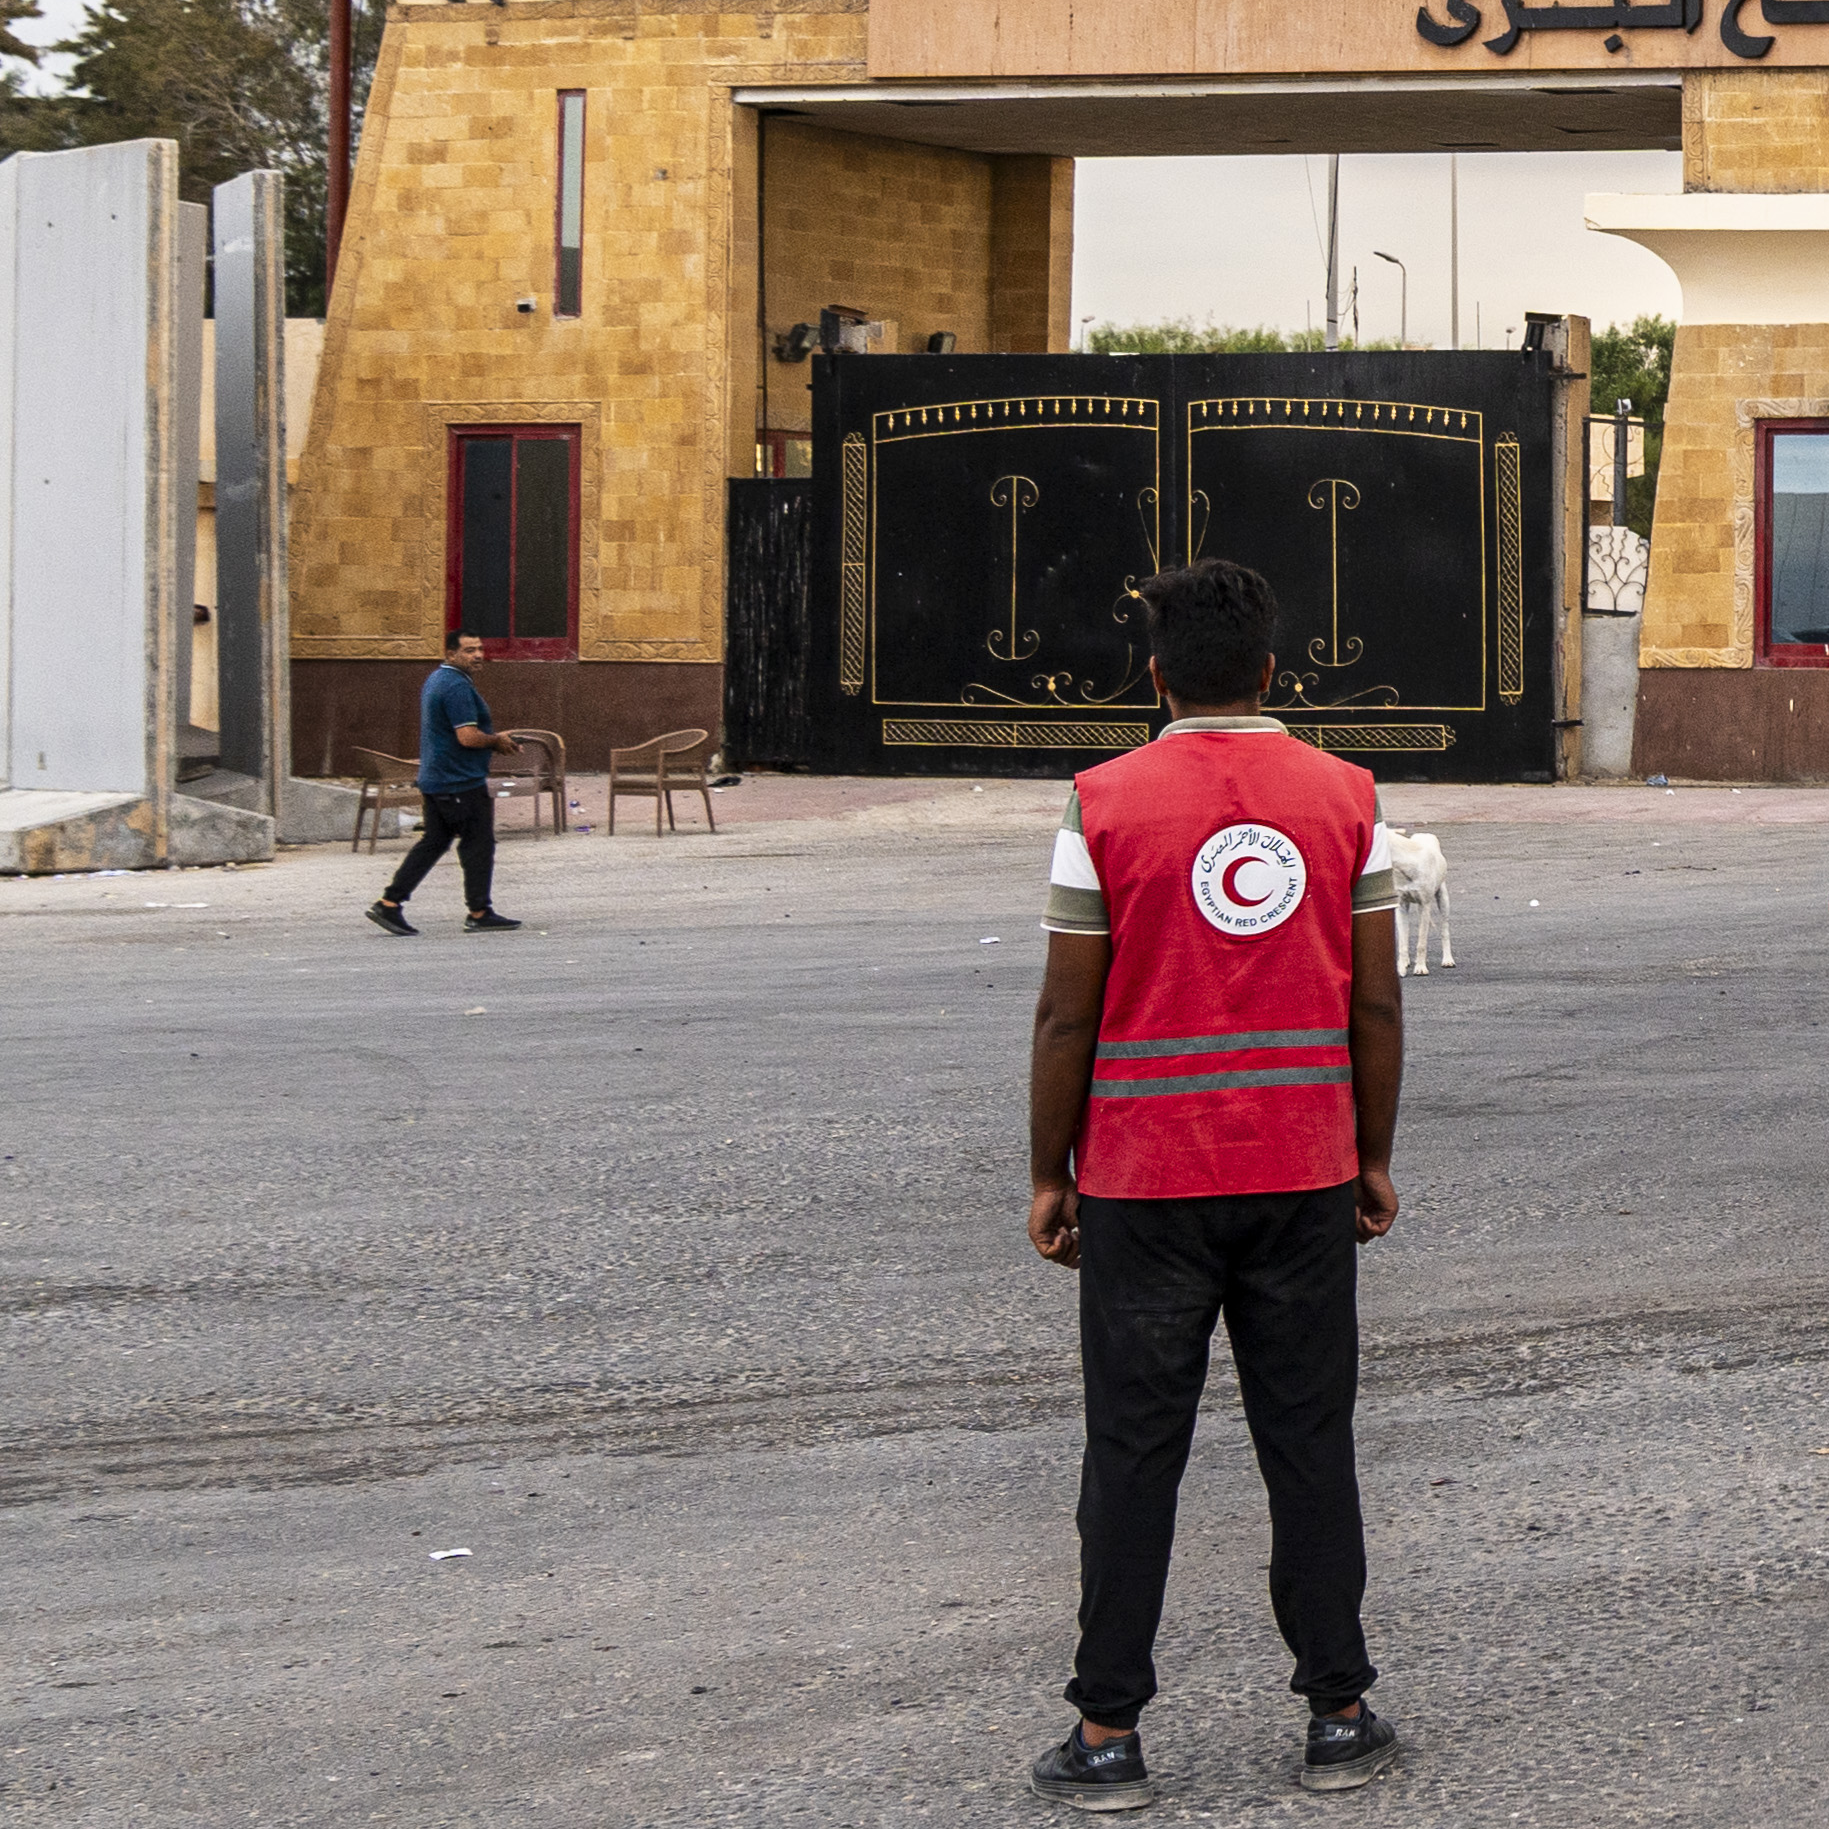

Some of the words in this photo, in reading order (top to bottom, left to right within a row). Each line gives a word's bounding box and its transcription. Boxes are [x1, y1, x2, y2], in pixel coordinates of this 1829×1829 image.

[1201, 881, 1232, 924] EGYPTIAN
[1235, 918, 1258, 927] RED
[1260, 877, 1297, 923] CRESCENT
